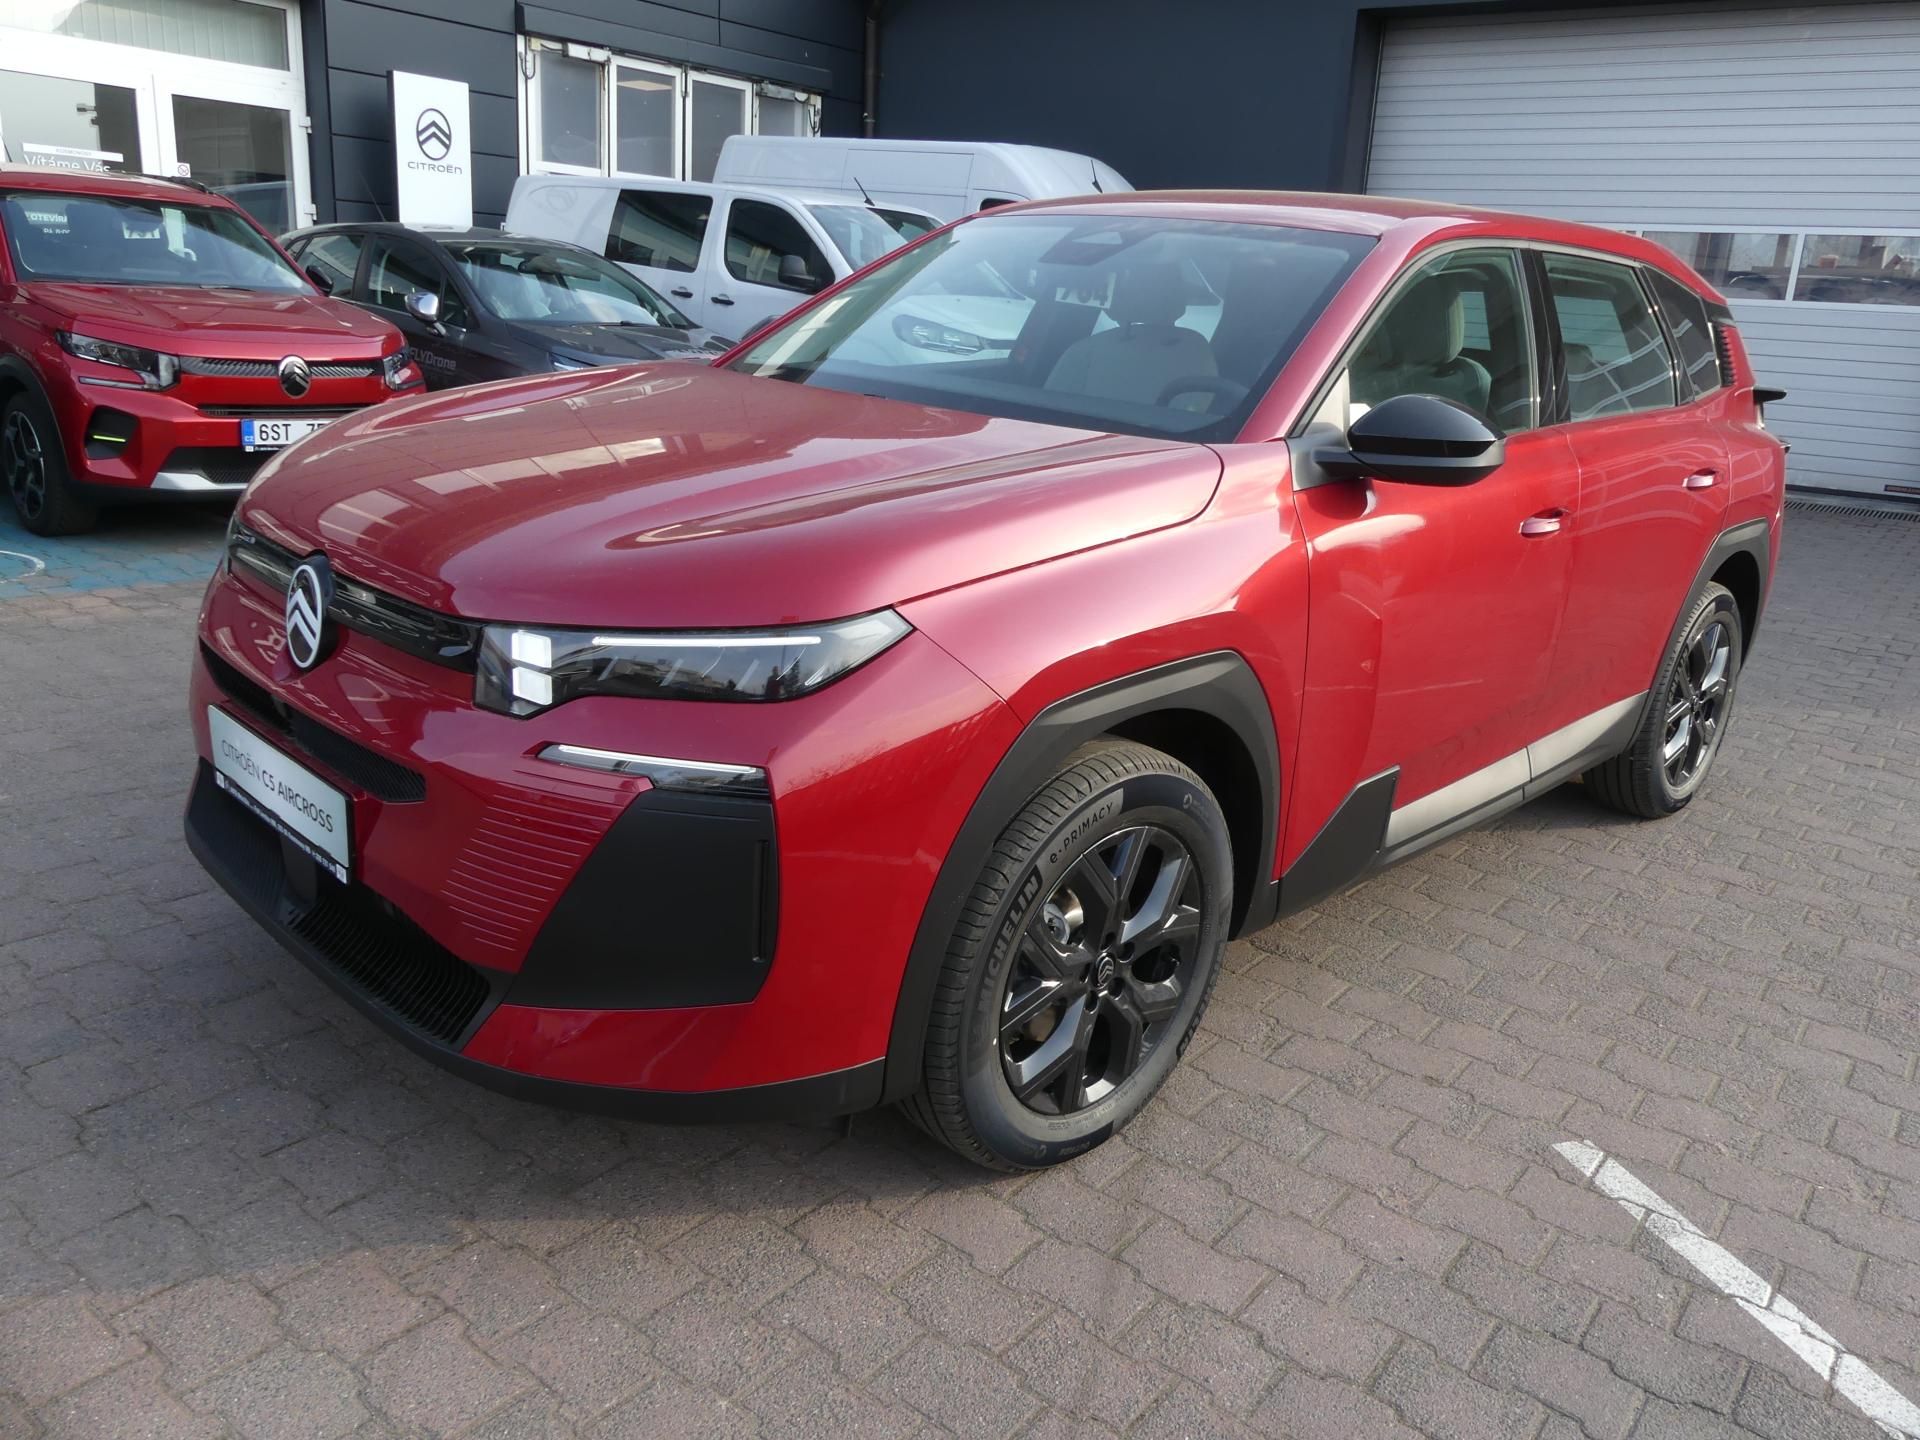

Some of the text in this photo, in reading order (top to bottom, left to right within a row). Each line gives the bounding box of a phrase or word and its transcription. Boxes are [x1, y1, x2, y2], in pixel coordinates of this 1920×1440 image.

[23, 153, 111, 173] Vítáme Vás
[259, 423, 291, 441] 6ST
[221, 740, 260, 780] CITROËN
[262, 770, 275, 792] C5
[278, 781, 333, 833] AIRCROSS
[976, 873, 1039, 1013] MICHELIN
